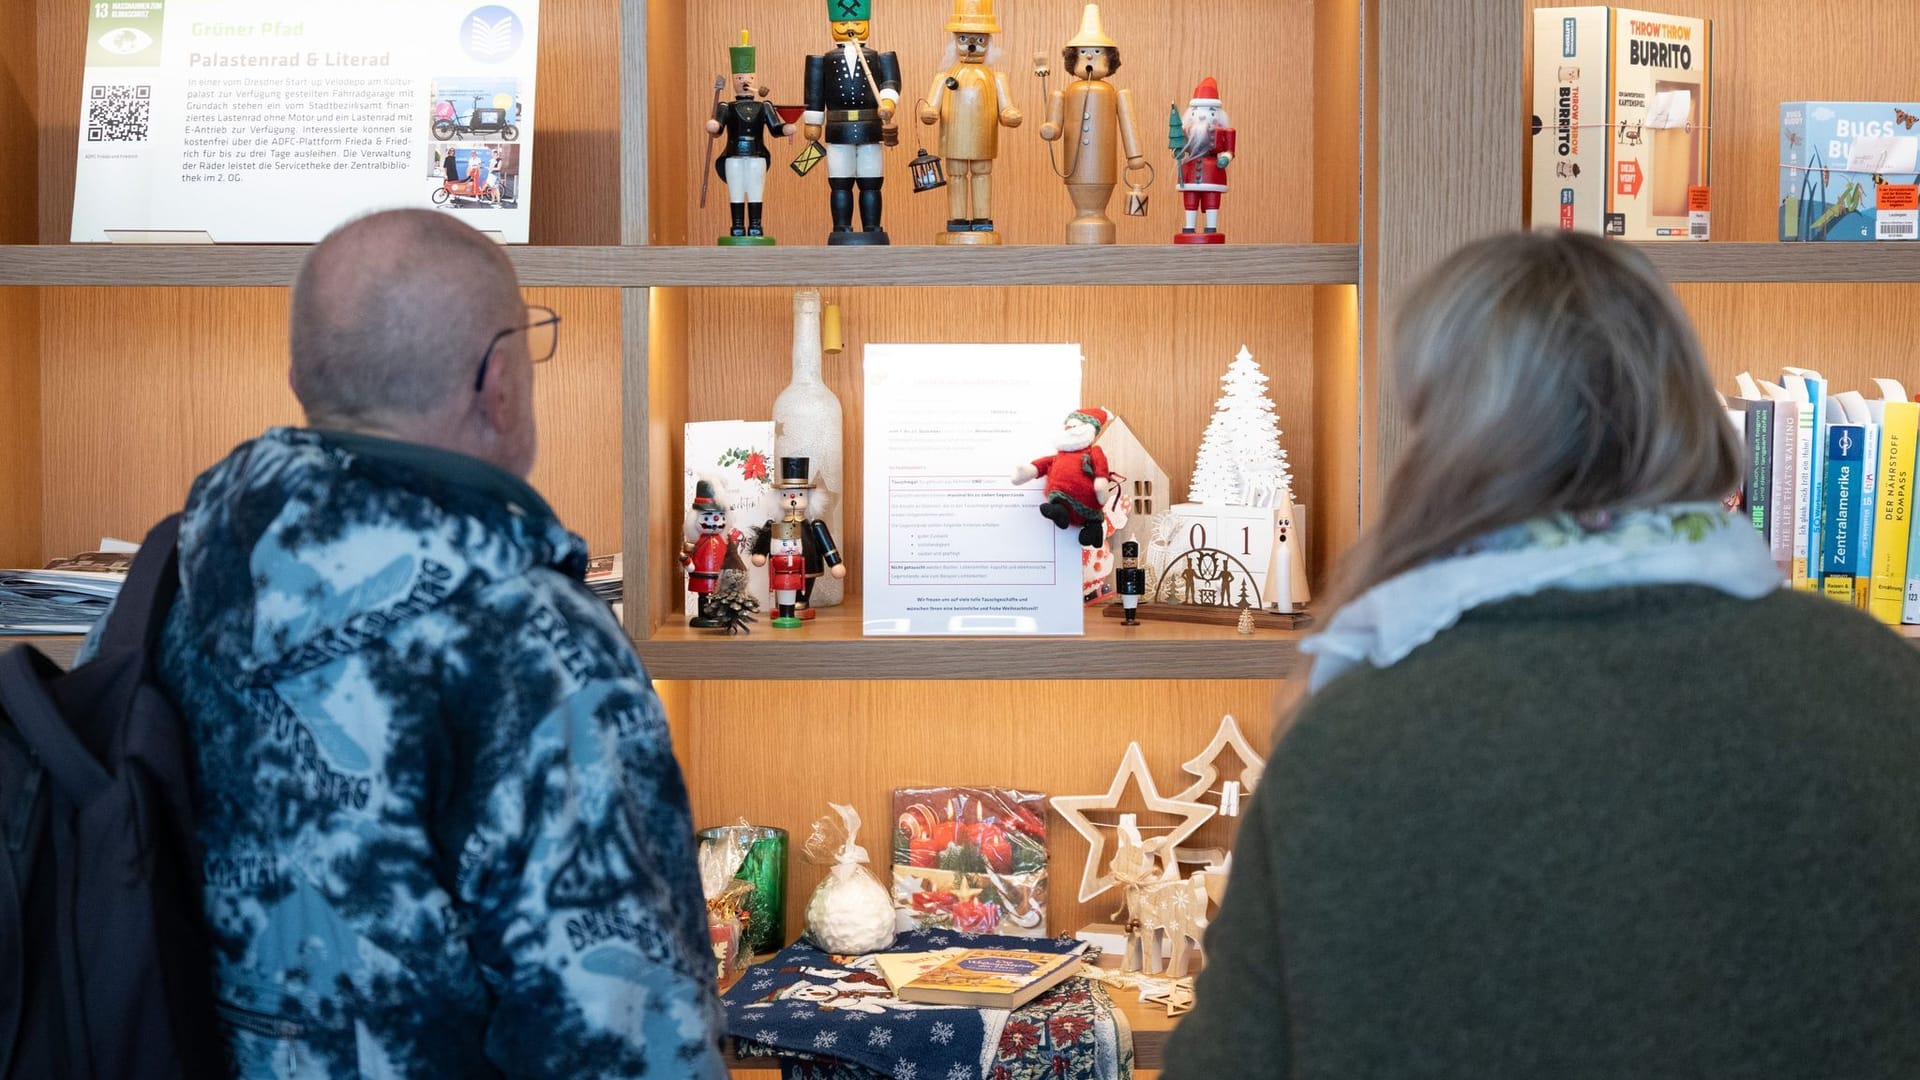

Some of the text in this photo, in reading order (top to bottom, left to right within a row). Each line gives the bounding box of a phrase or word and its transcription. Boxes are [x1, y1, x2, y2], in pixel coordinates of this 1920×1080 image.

[95, 3, 109, 18] 13
[191, 21, 304, 37] Grüner Pfad
[1630, 20, 1691, 40] THROW THROW
[190, 52, 390, 67] Palastenrad & Literad
[1630, 40, 1691, 70] BURRITO
[198, 79, 221, 87] einer
[222, 79, 241, 87] vom
[244, 78, 283, 87] Dresdner
[187, 91, 214, 100] palast
[285, 90, 329, 100] gestellten
[332, 89, 395, 99] Fahrradgarage
[387, 101, 412, 109] finan-
[186, 114, 215, 122] ziertes
[218, 114, 261, 122] Lastenrad
[352, 113, 395, 121] Lastenrad
[1558, 87, 1570, 156] BURRITO
[185, 126, 227, 134] E-Antrieb
[1837, 119, 1895, 137] BUGS
[184, 137, 228, 146] kostenfrei
[232, 138, 252, 146] über
[272, 137, 341, 145] ADFC-Plattform
[376, 137, 382, 145] &
[386, 137, 411, 145] Fried-
[184, 150, 199, 158] rich
[219, 150, 232, 158] bis
[270, 150, 290, 160] Tage
[344, 149, 357, 157] Die
[361, 150, 411, 159] Verwaltung
[182, 162, 196, 170] der
[200, 162, 225, 170] Räder
[275, 162, 331, 170] Servicetheke
[182, 174, 201, 182] thek
[1782, 417, 1794, 548] THE LIFE THAT'S WAITING
[1885, 434, 1899, 520] DER NÄHRSTOFF
[1800, 487, 1808, 503] mich
[1896, 471, 1907, 521] KOMPASS
[1834, 466, 1850, 564] Zentralamerika
[1798, 524, 1807, 535] Ich
[1190, 523, 1251, 556] 0 1
